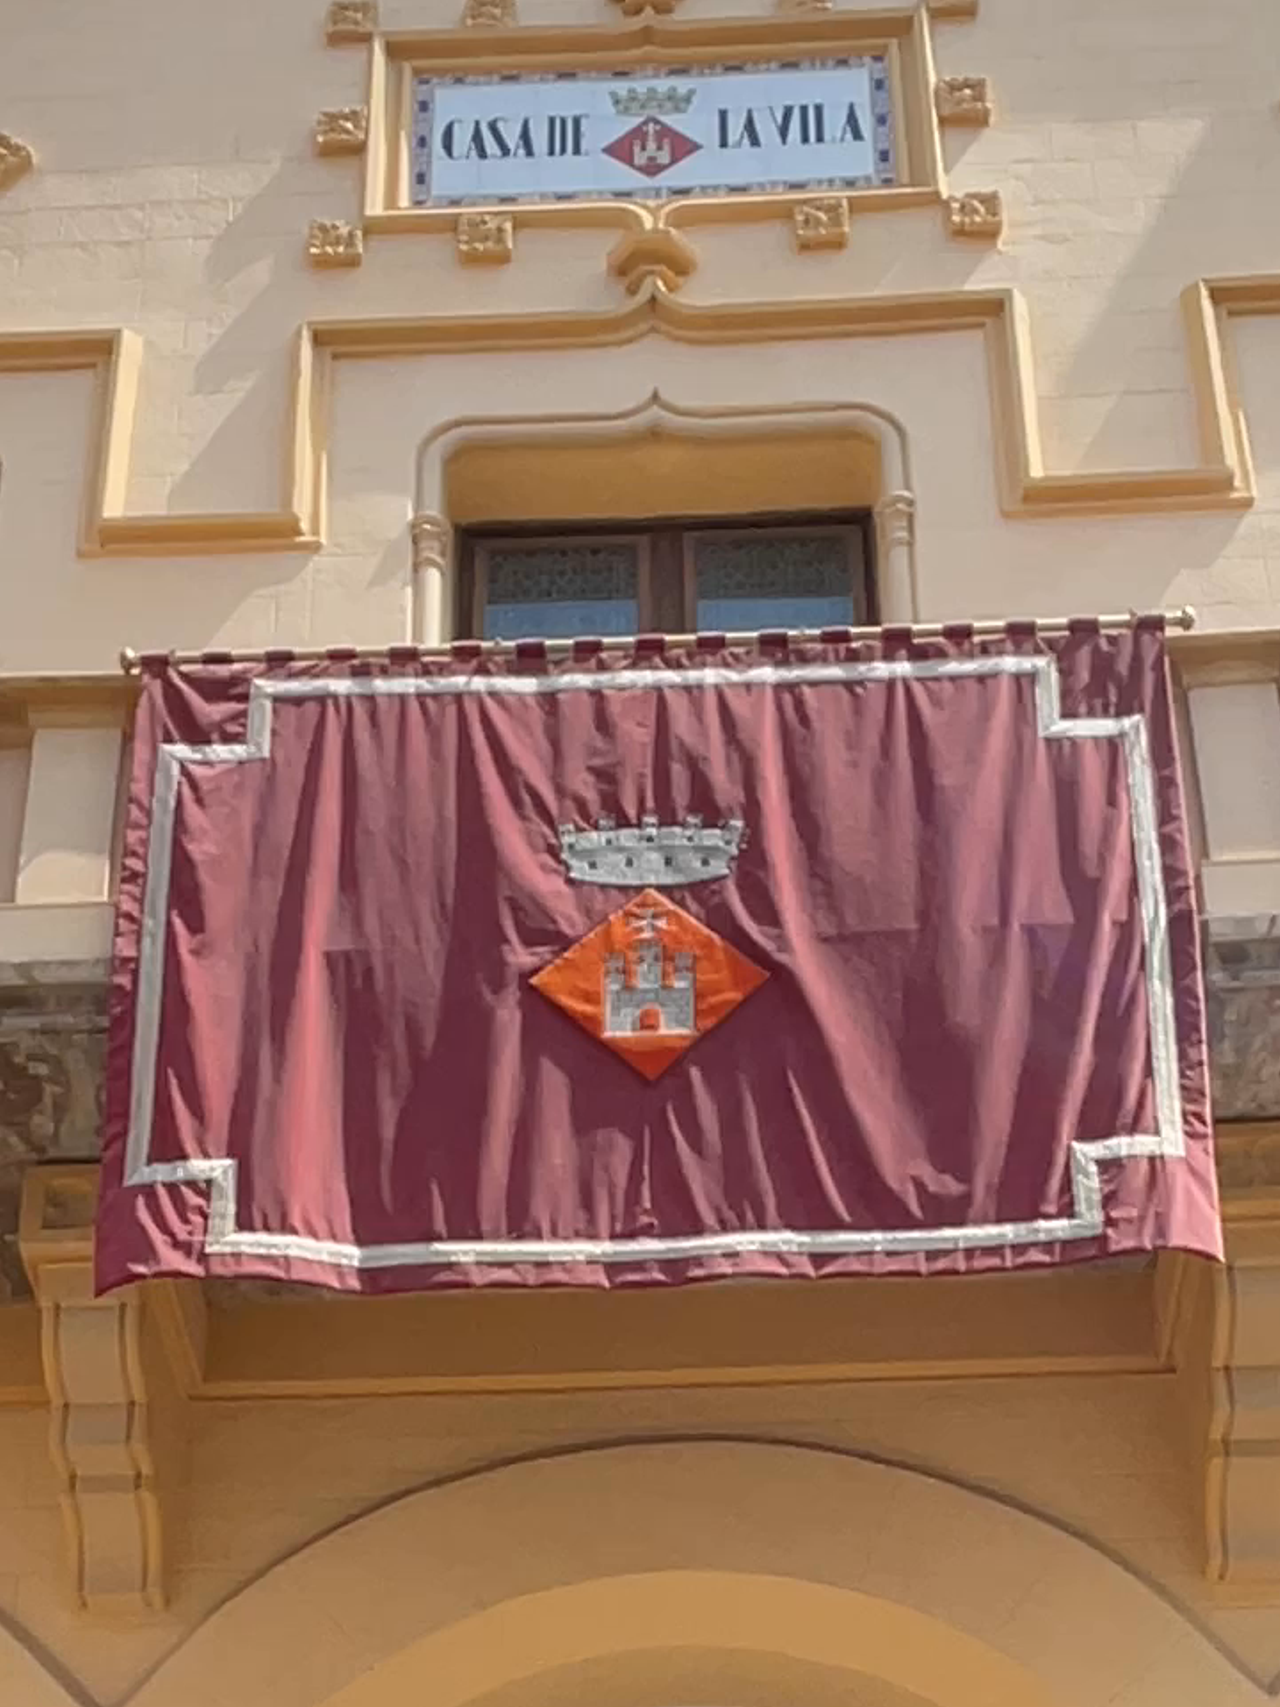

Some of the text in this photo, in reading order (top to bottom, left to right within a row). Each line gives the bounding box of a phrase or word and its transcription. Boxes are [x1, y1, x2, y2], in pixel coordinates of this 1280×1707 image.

[440, 100, 866, 161] CASA DE LA VILA
